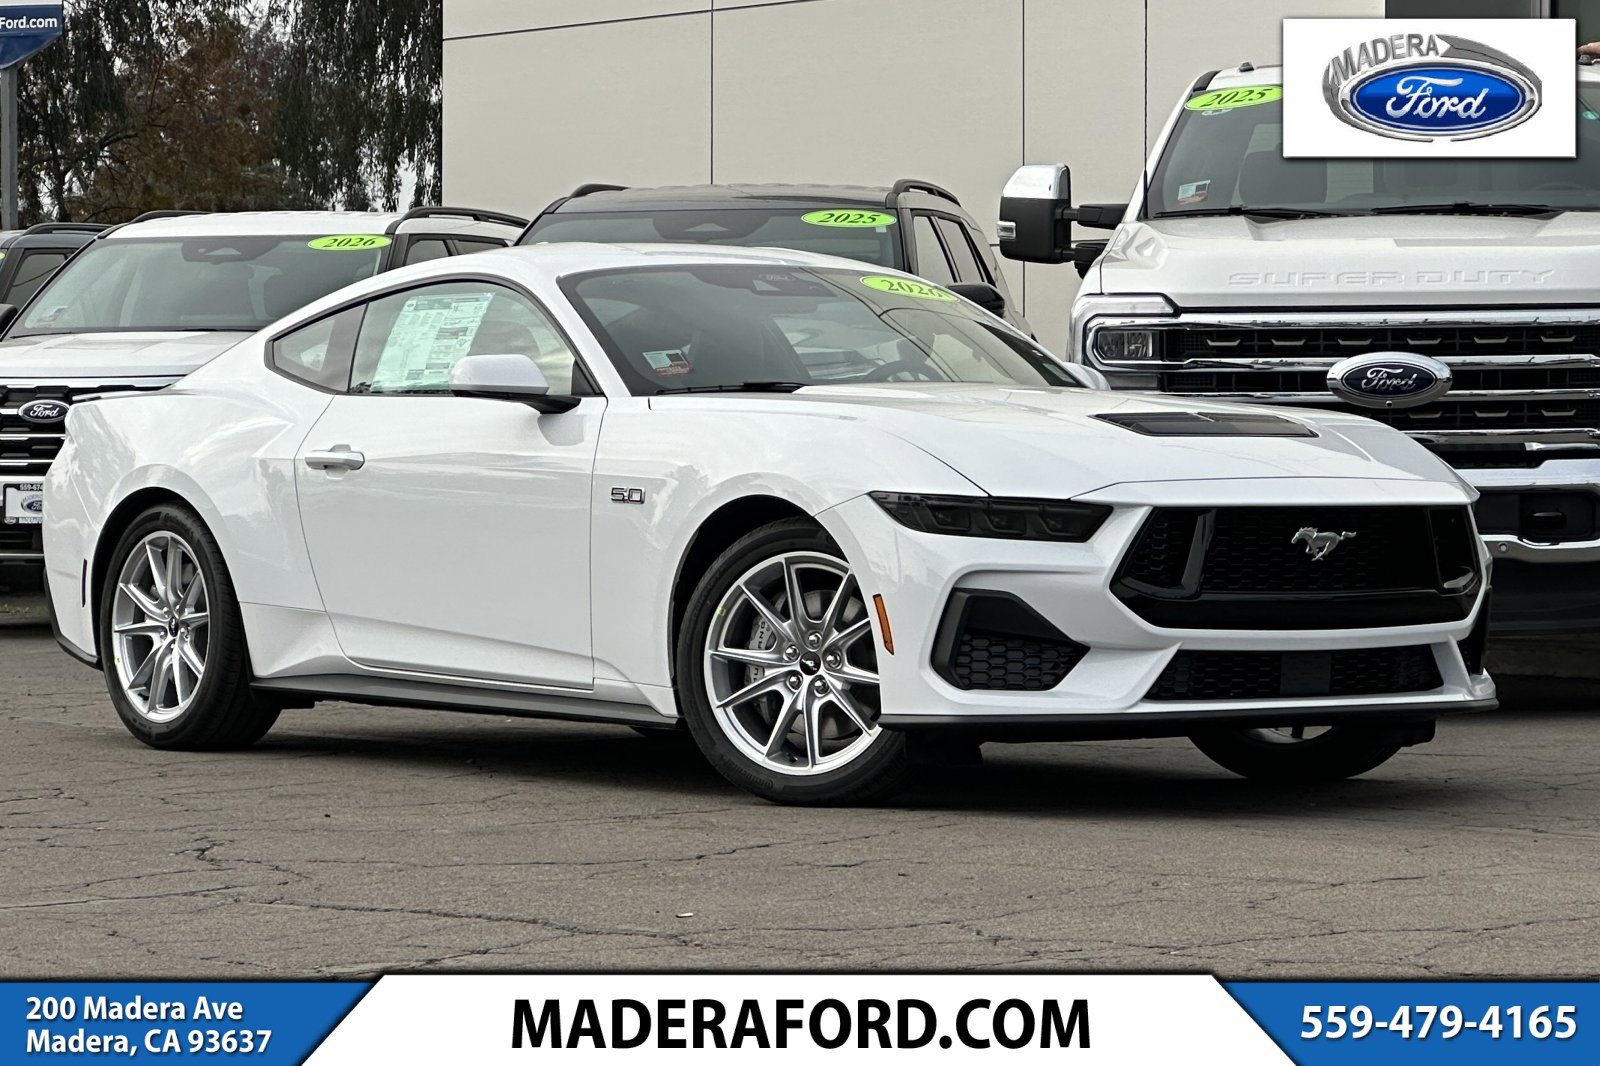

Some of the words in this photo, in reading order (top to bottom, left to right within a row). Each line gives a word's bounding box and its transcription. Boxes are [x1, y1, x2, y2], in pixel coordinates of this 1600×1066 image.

[1199, 88, 1273, 108] 2025
[817, 212, 881, 224] 2025
[322, 236, 377, 248] 2026
[1228, 271, 1406, 286] SUPER
[1416, 269, 1555, 285] DUTY
[1361, 367, 1418, 391] Ford
[30, 404, 60, 417] Ford
